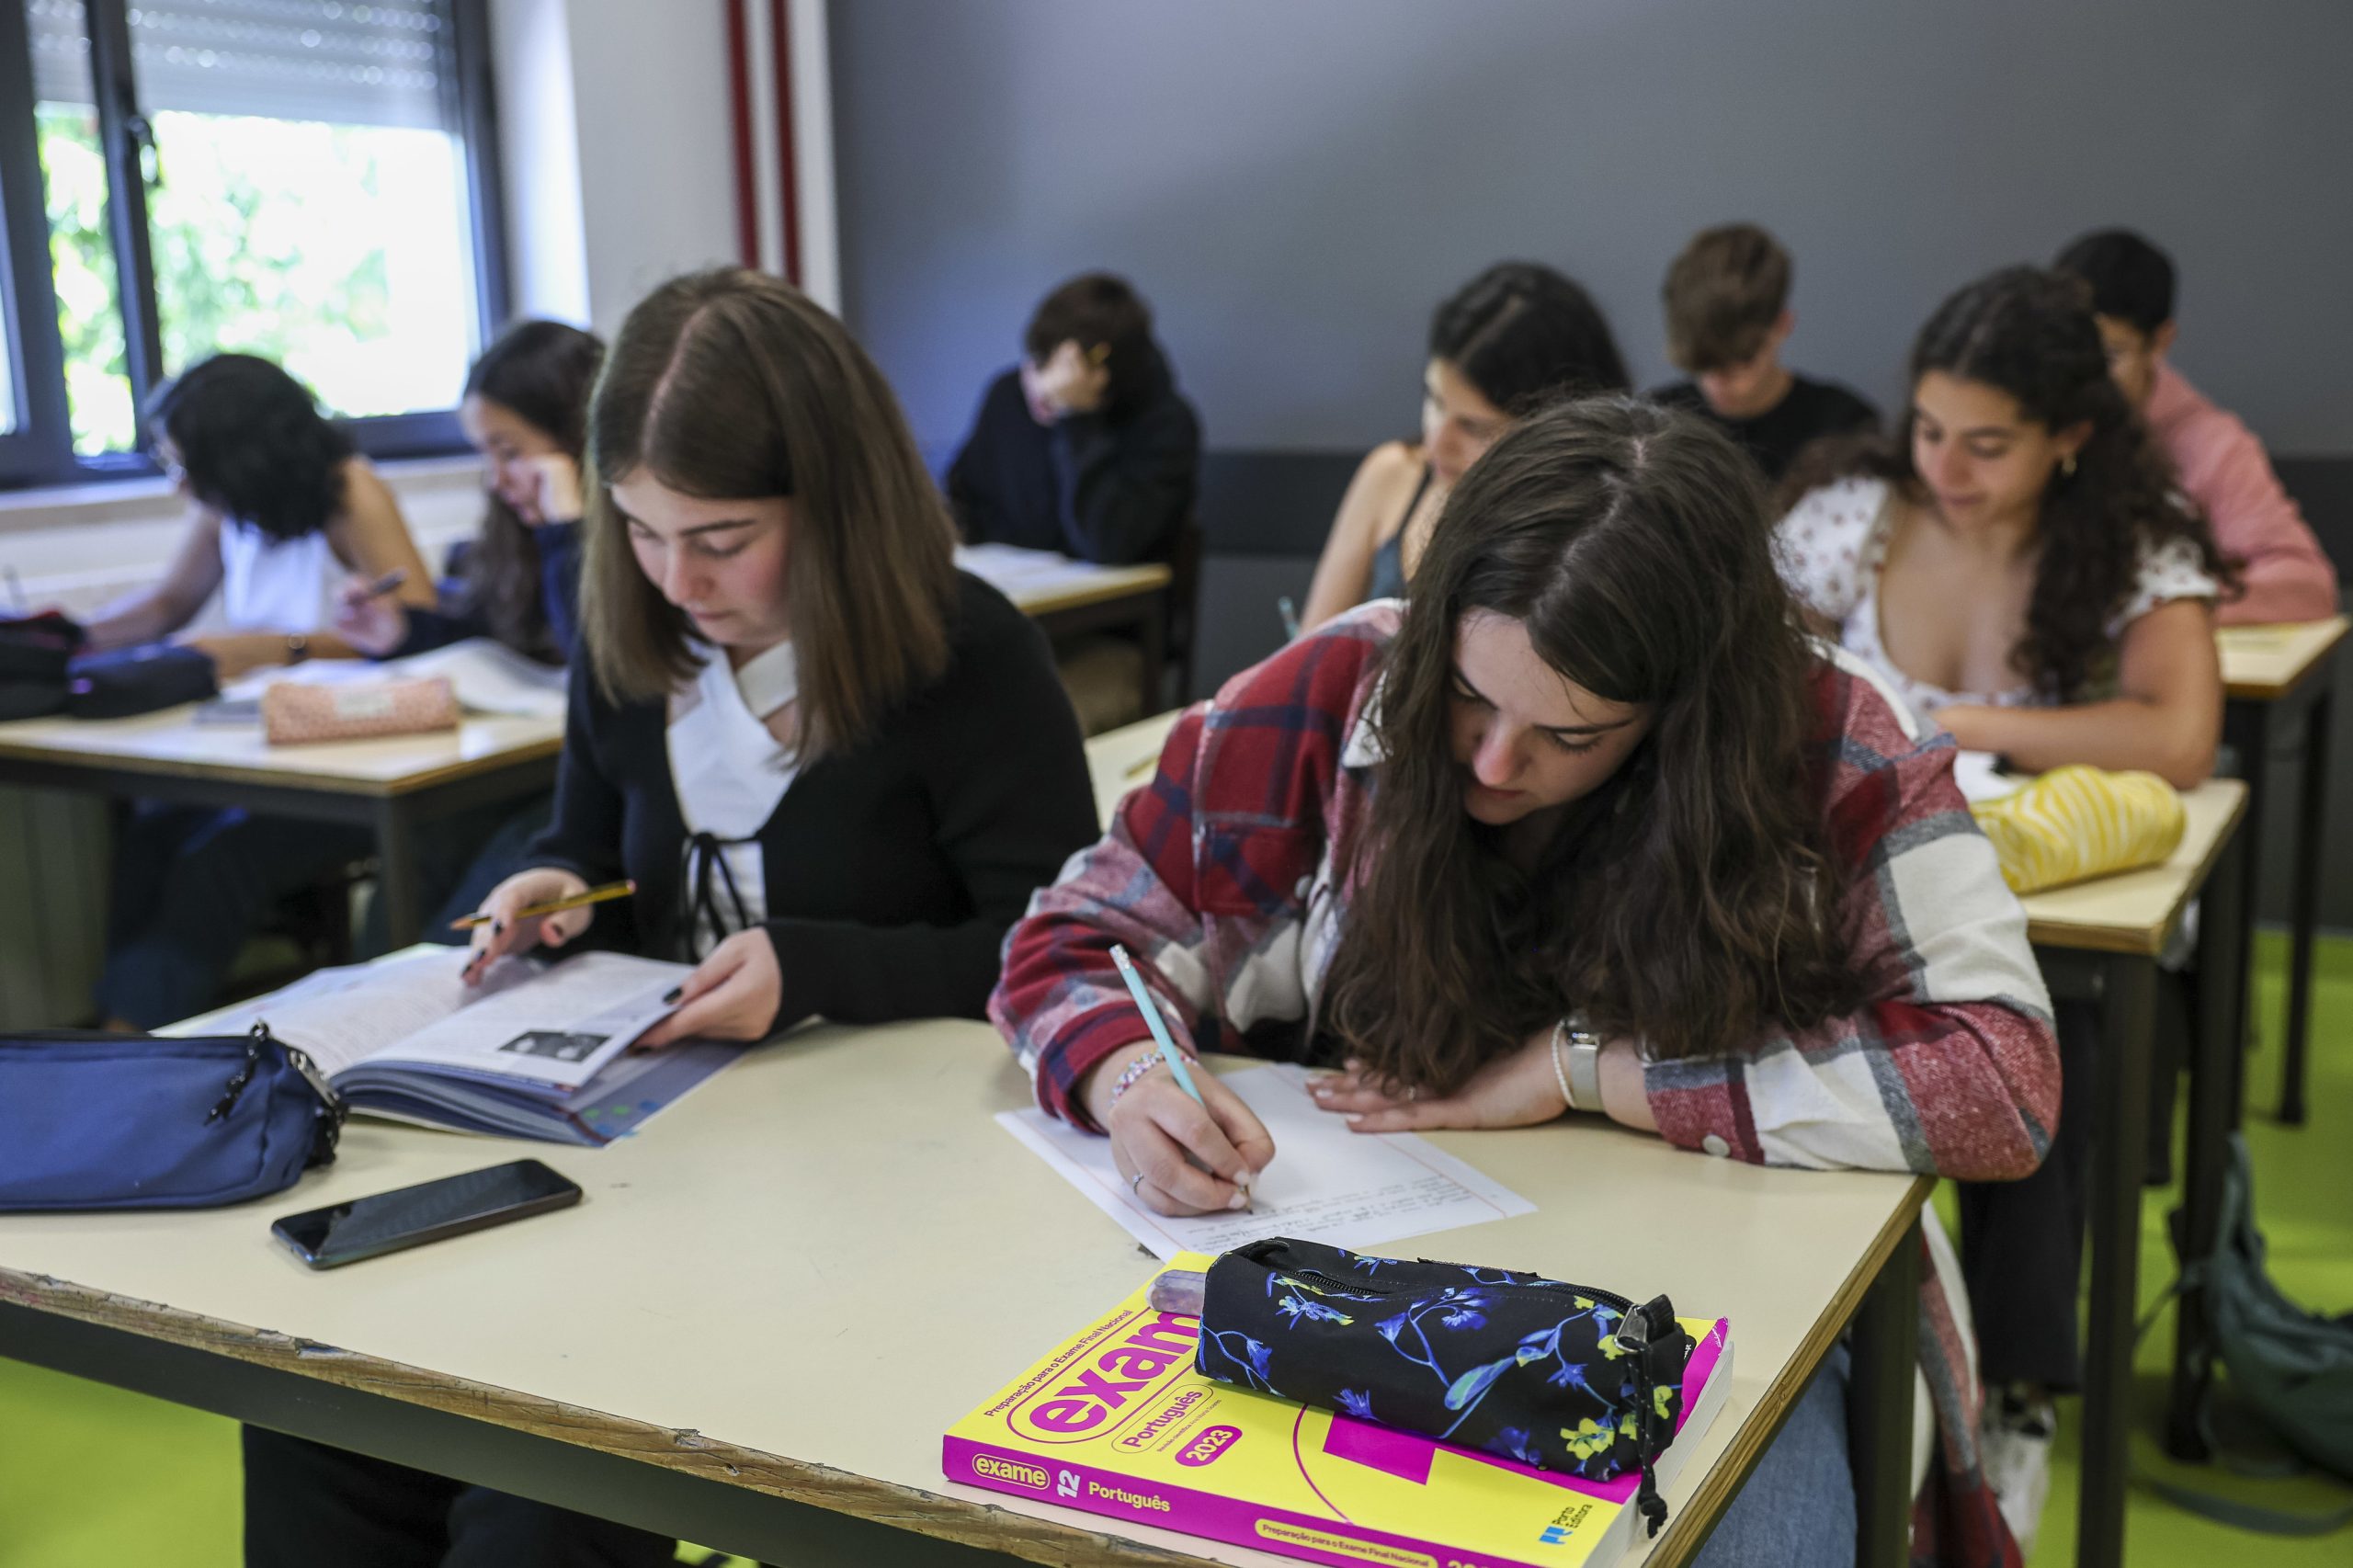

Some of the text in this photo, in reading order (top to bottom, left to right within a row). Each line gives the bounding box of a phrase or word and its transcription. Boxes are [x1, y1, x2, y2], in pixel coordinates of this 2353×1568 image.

[983, 1381, 1035, 1416] Preparação
[1032, 1366, 1054, 1382] para
[1053, 1343, 1086, 1364] Exame
[1078, 1329, 1103, 1345] Final
[1097, 1310, 1133, 1333] Nacional
[1029, 1311, 1201, 1433] exam
[1121, 1391, 1203, 1448] Português
[1186, 1429, 1233, 1462] 2023
[976, 1457, 1171, 1512] exame 12 Português
[1262, 1524, 1311, 1541] Preparação
[1312, 1537, 1331, 1546] para
[1339, 1541, 1368, 1553] Exame
[1369, 1548, 1390, 1560] Final
[1391, 1551, 1429, 1567] Nacional
